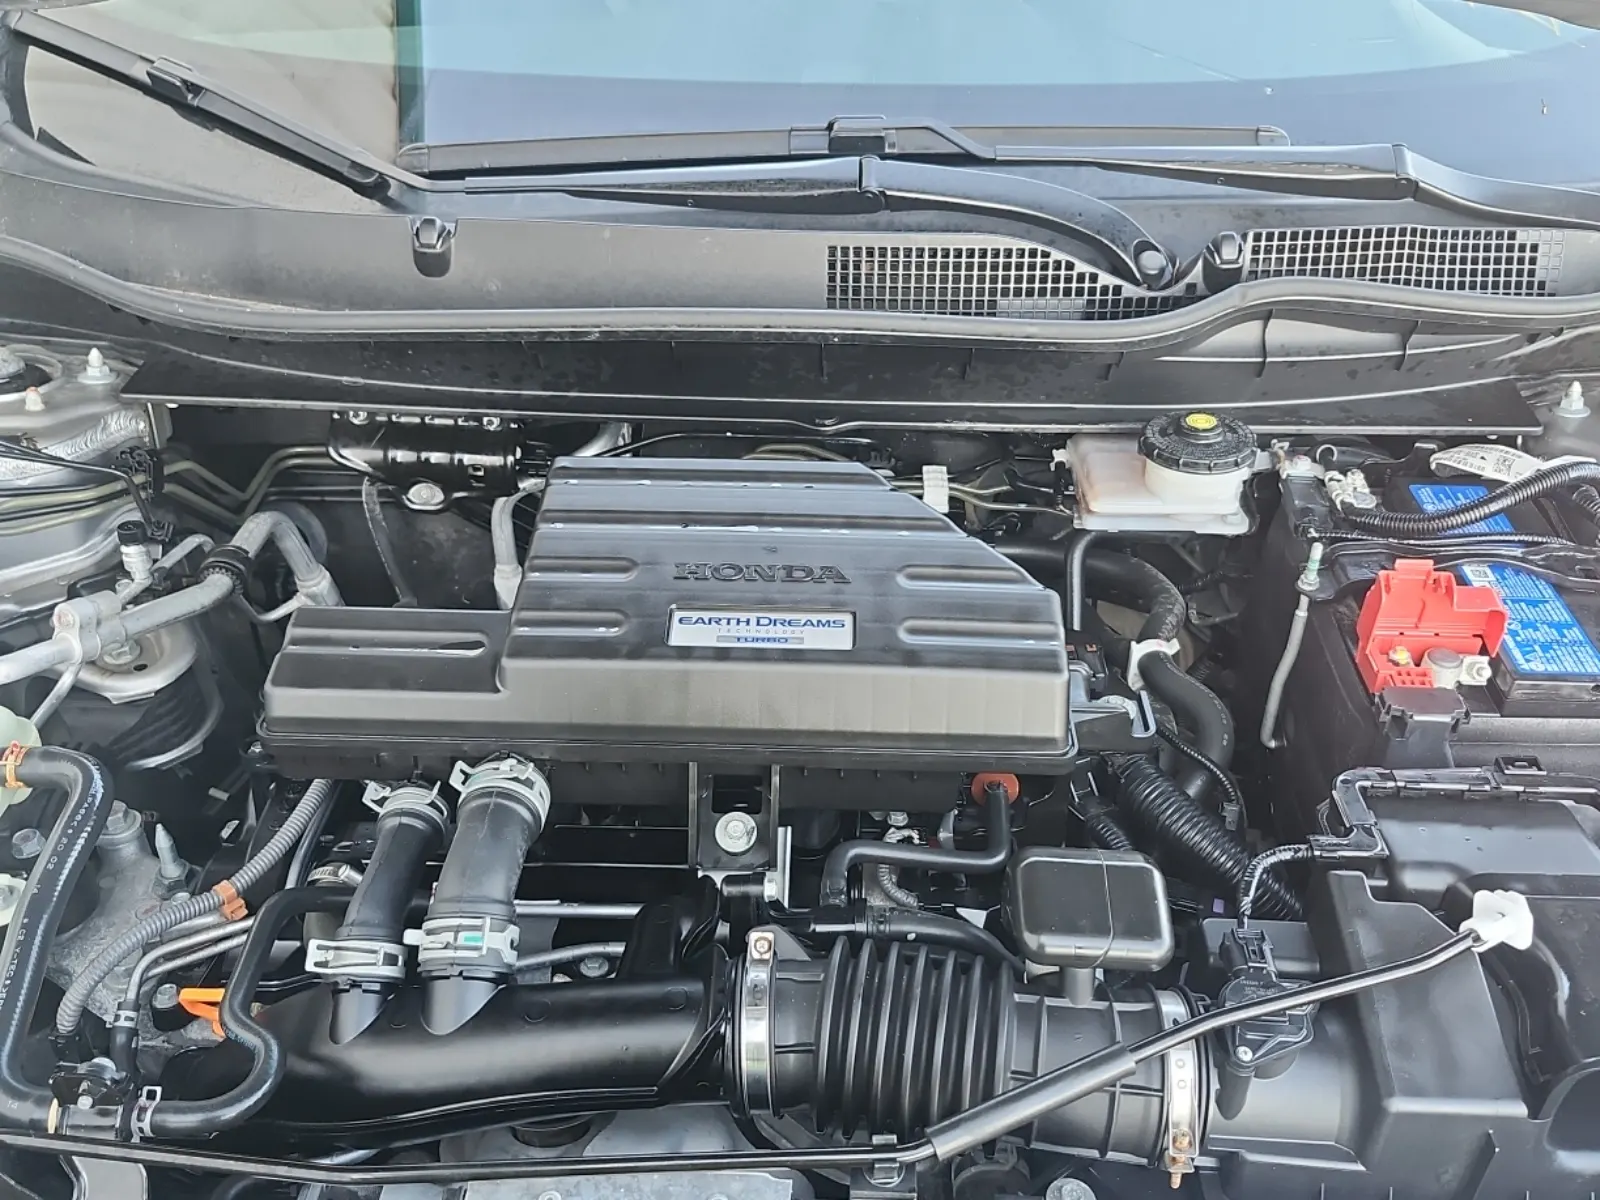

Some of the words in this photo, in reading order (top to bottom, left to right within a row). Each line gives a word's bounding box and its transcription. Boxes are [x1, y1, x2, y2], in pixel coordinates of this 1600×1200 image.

[673, 562, 851, 583] HONDA
[678, 616, 750, 627] EARTH
[756, 616, 845, 628] DREAMS
[736, 636, 788, 644] TURBO
